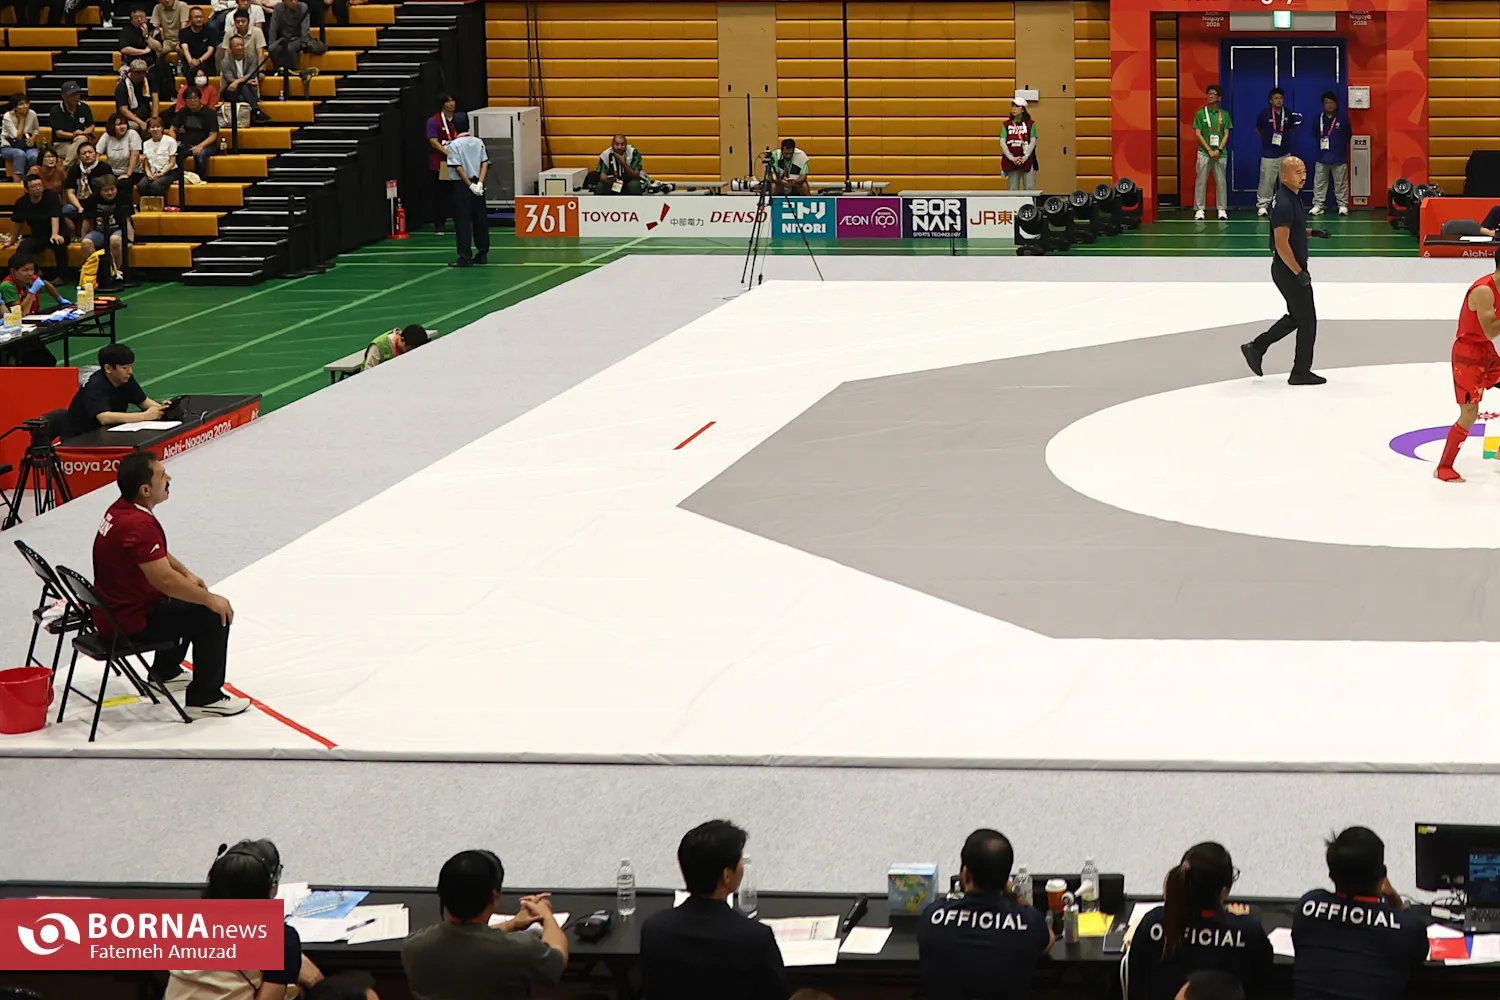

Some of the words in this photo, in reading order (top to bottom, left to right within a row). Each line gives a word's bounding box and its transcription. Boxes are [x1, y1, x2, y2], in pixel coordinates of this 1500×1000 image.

[582, 211, 639, 223] TOYOTA
[710, 211, 768, 223] DENSO
[782, 201, 827, 220] ニトリ
[670, 218, 704, 227] 中部電力
[782, 223, 827, 233] NITORI
[912, 215, 961, 231] NAN
[163, 429, 213, 459] Aichi-Nagoya
[213, 420, 232, 437] 2026
[930, 908, 1028, 931] OFFICIAL
[1302, 900, 1401, 930] OFFICIAL
[1150, 923, 1246, 948] OICIAL
